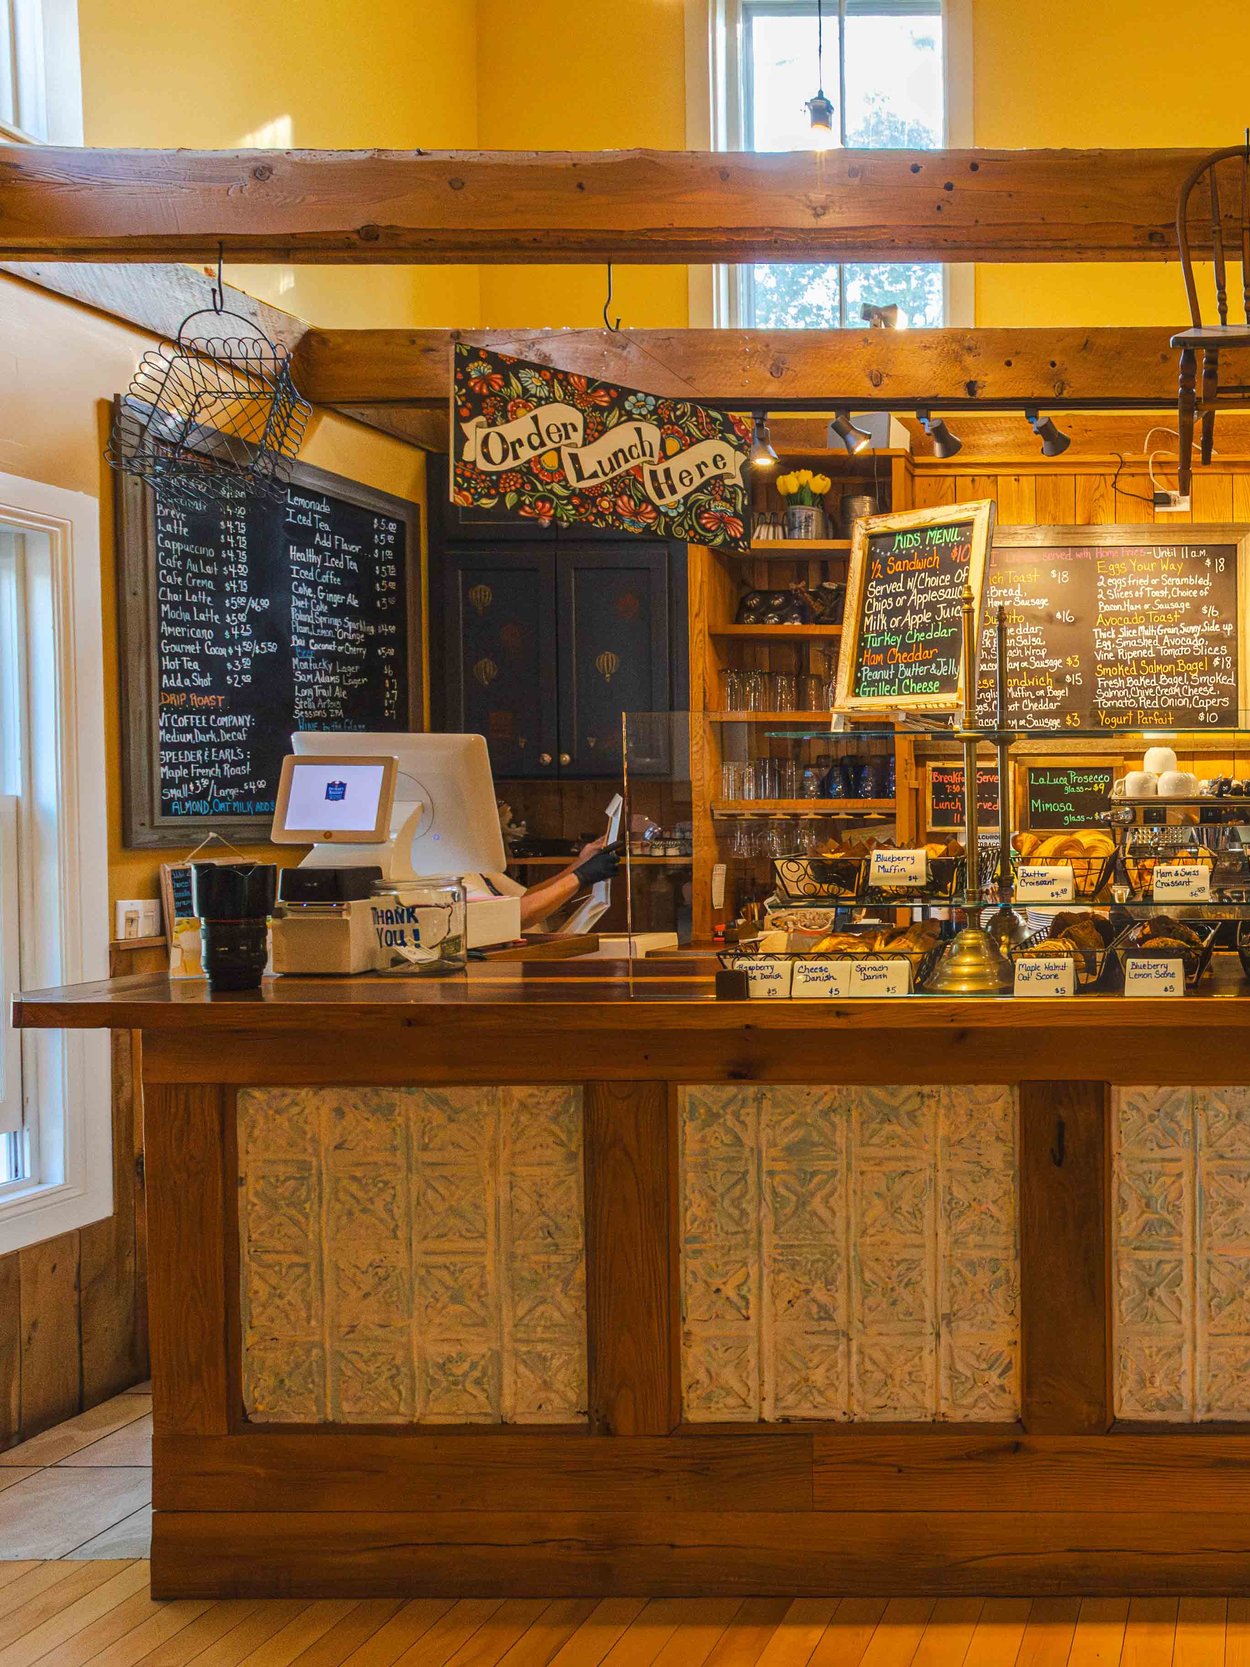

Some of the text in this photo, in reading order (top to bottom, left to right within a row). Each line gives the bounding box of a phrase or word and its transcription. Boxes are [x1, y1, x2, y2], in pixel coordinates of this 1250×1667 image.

[480, 414, 727, 501] Order Lunch Here
[287, 488, 330, 514] Lemonade
[893, 533, 920, 551] KIDS
[887, 547, 939, 574] Sandwich
[951, 543, 971, 563] $10
[1096, 560, 1127, 575] Eggs
[1130, 559, 1156, 572] Your
[1160, 559, 1184, 575] Way
[867, 573, 904, 597] Served
[865, 586, 963, 618] Chips or Applesauc
[864, 613, 887, 632] Milk
[890, 617, 902, 628] or
[901, 609, 931, 630] Apple
[1096, 614, 1145, 627] Avocado
[1146, 611, 1181, 623] Toast
[906, 622, 957, 643] Cheddar
[863, 643, 938, 666] Ham Cheddar
[162, 657, 200, 670] Hot Tea
[1176, 657, 1208, 676] Bagel
[861, 665, 895, 681] Peanut
[860, 678, 940, 697] Grilled Cheese
[158, 692, 225, 708] DRIP ROAST
[1098, 710, 1218, 729] Yogurt Parfait $10
[160, 762, 251, 783] Maple French Roast
[1067, 770, 1110, 784] Prosecco
[933, 798, 962, 811] Lunch
[1031, 799, 1074, 813] Mimosa
[874, 854, 915, 864] Blueberry
[877, 865, 906, 873] Muffin
[1156, 869, 1173, 878] Ham
[1180, 868, 1199, 877] Swiss
[1156, 878, 1193, 888] Croissant
[371, 906, 419, 925] THANK
[798, 965, 829, 974] Cheese
[855, 965, 888, 976] Spinach
[1130, 961, 1168, 971] Blueberry
[803, 974, 837, 983] Danish
[1036, 972, 1059, 980] Scone
[1128, 970, 1176, 979] Lemon Scone
[1163, 985, 1175, 993] $5
